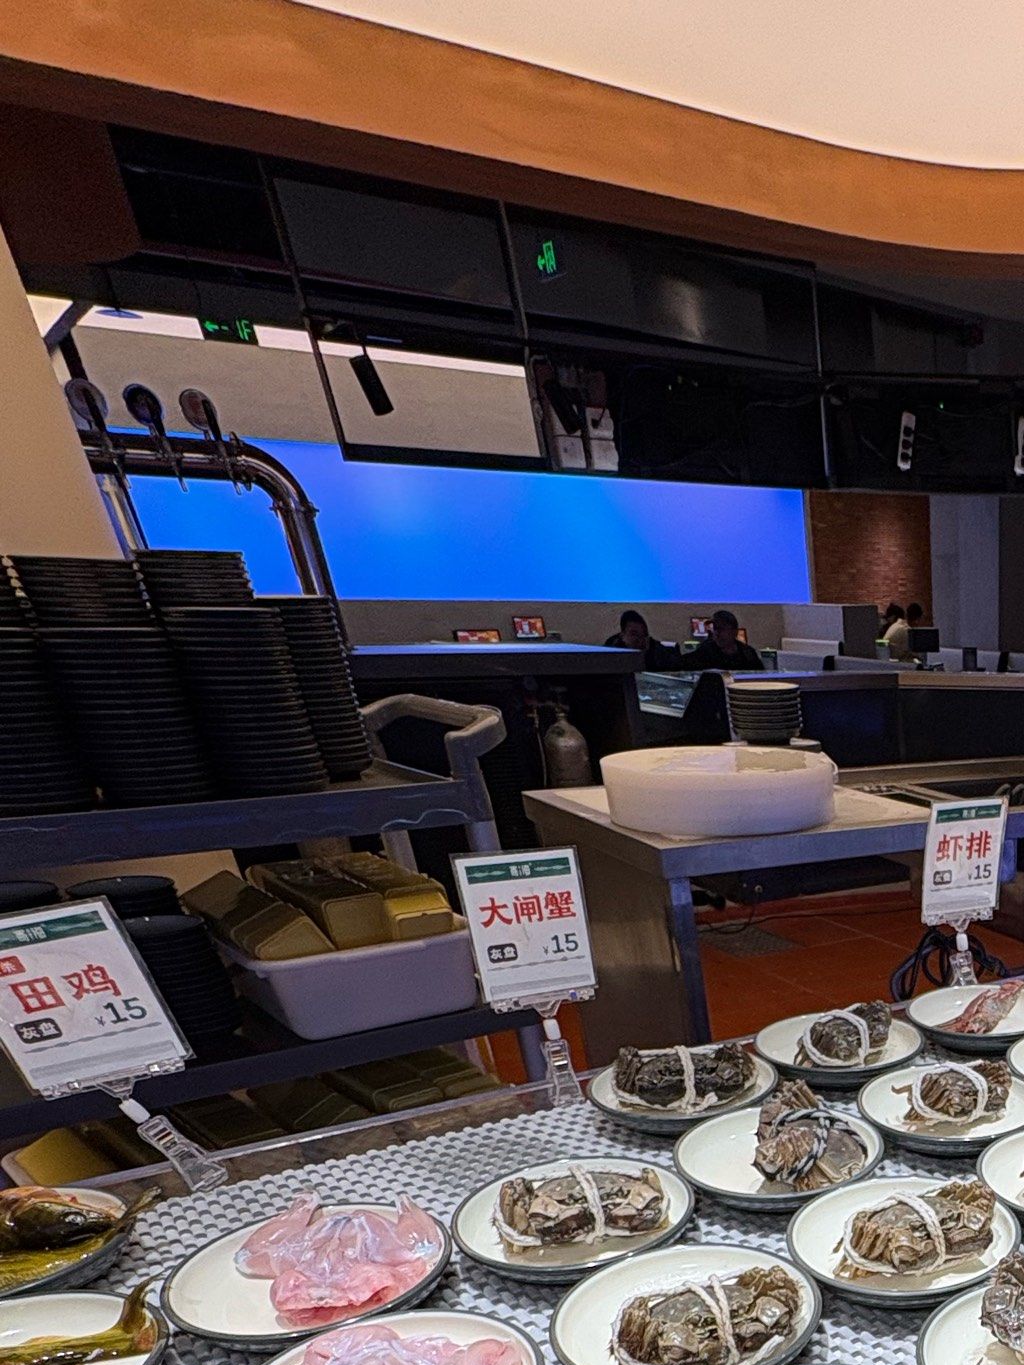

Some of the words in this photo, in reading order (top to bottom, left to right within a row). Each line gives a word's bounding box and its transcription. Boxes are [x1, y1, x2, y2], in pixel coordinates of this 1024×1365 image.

[936, 830, 993, 862] 虾排
[968, 863, 992, 880] ¥15
[479, 890, 577, 929] 大闸蟹
[489, 946, 516, 960] 灰盘
[543, 932, 579, 956] ¥15
[8, 963, 122, 1014] 田鸡
[95, 997, 147, 1027] ¥15
[19, 1021, 60, 1040] 灰盘
